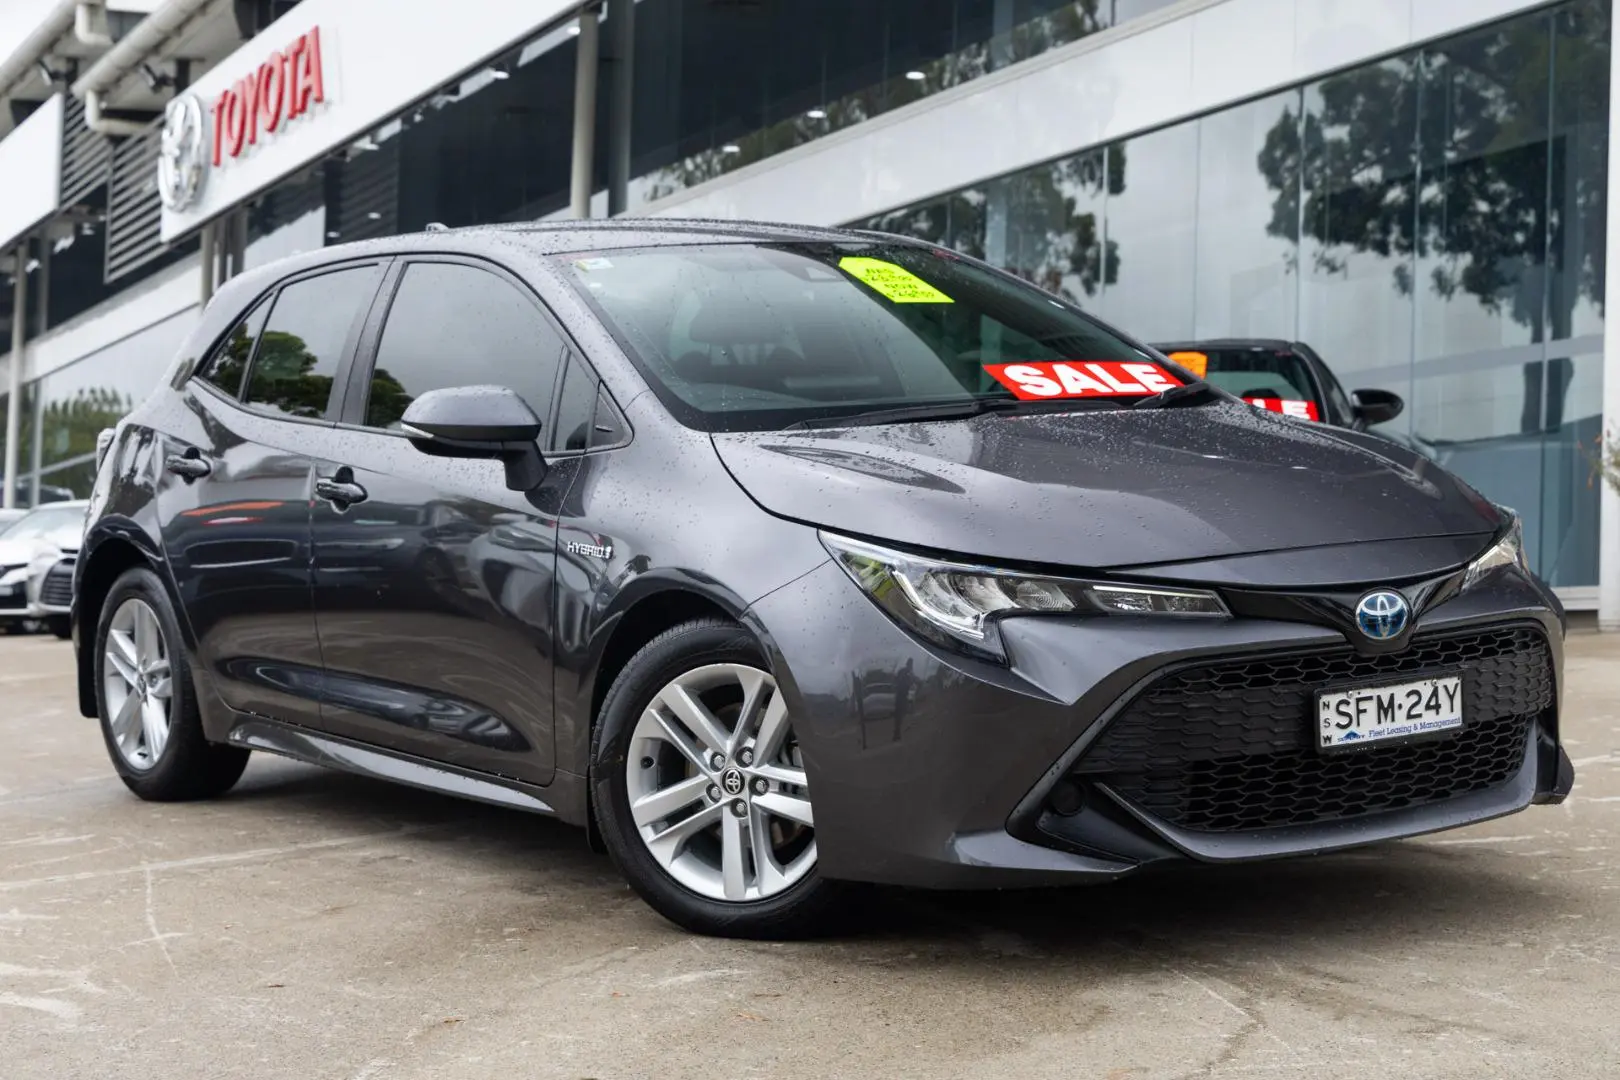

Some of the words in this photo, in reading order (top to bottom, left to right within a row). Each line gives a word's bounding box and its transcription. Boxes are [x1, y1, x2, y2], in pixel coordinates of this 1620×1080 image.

[211, 25, 325, 167] TOYOTA
[1003, 363, 1177, 397] SALE
[567, 541, 604, 558] HYBRID
[1368, 728, 1386, 738] Fleet
[1386, 724, 1413, 735] Leasing
[1419, 717, 1461, 730] Management
